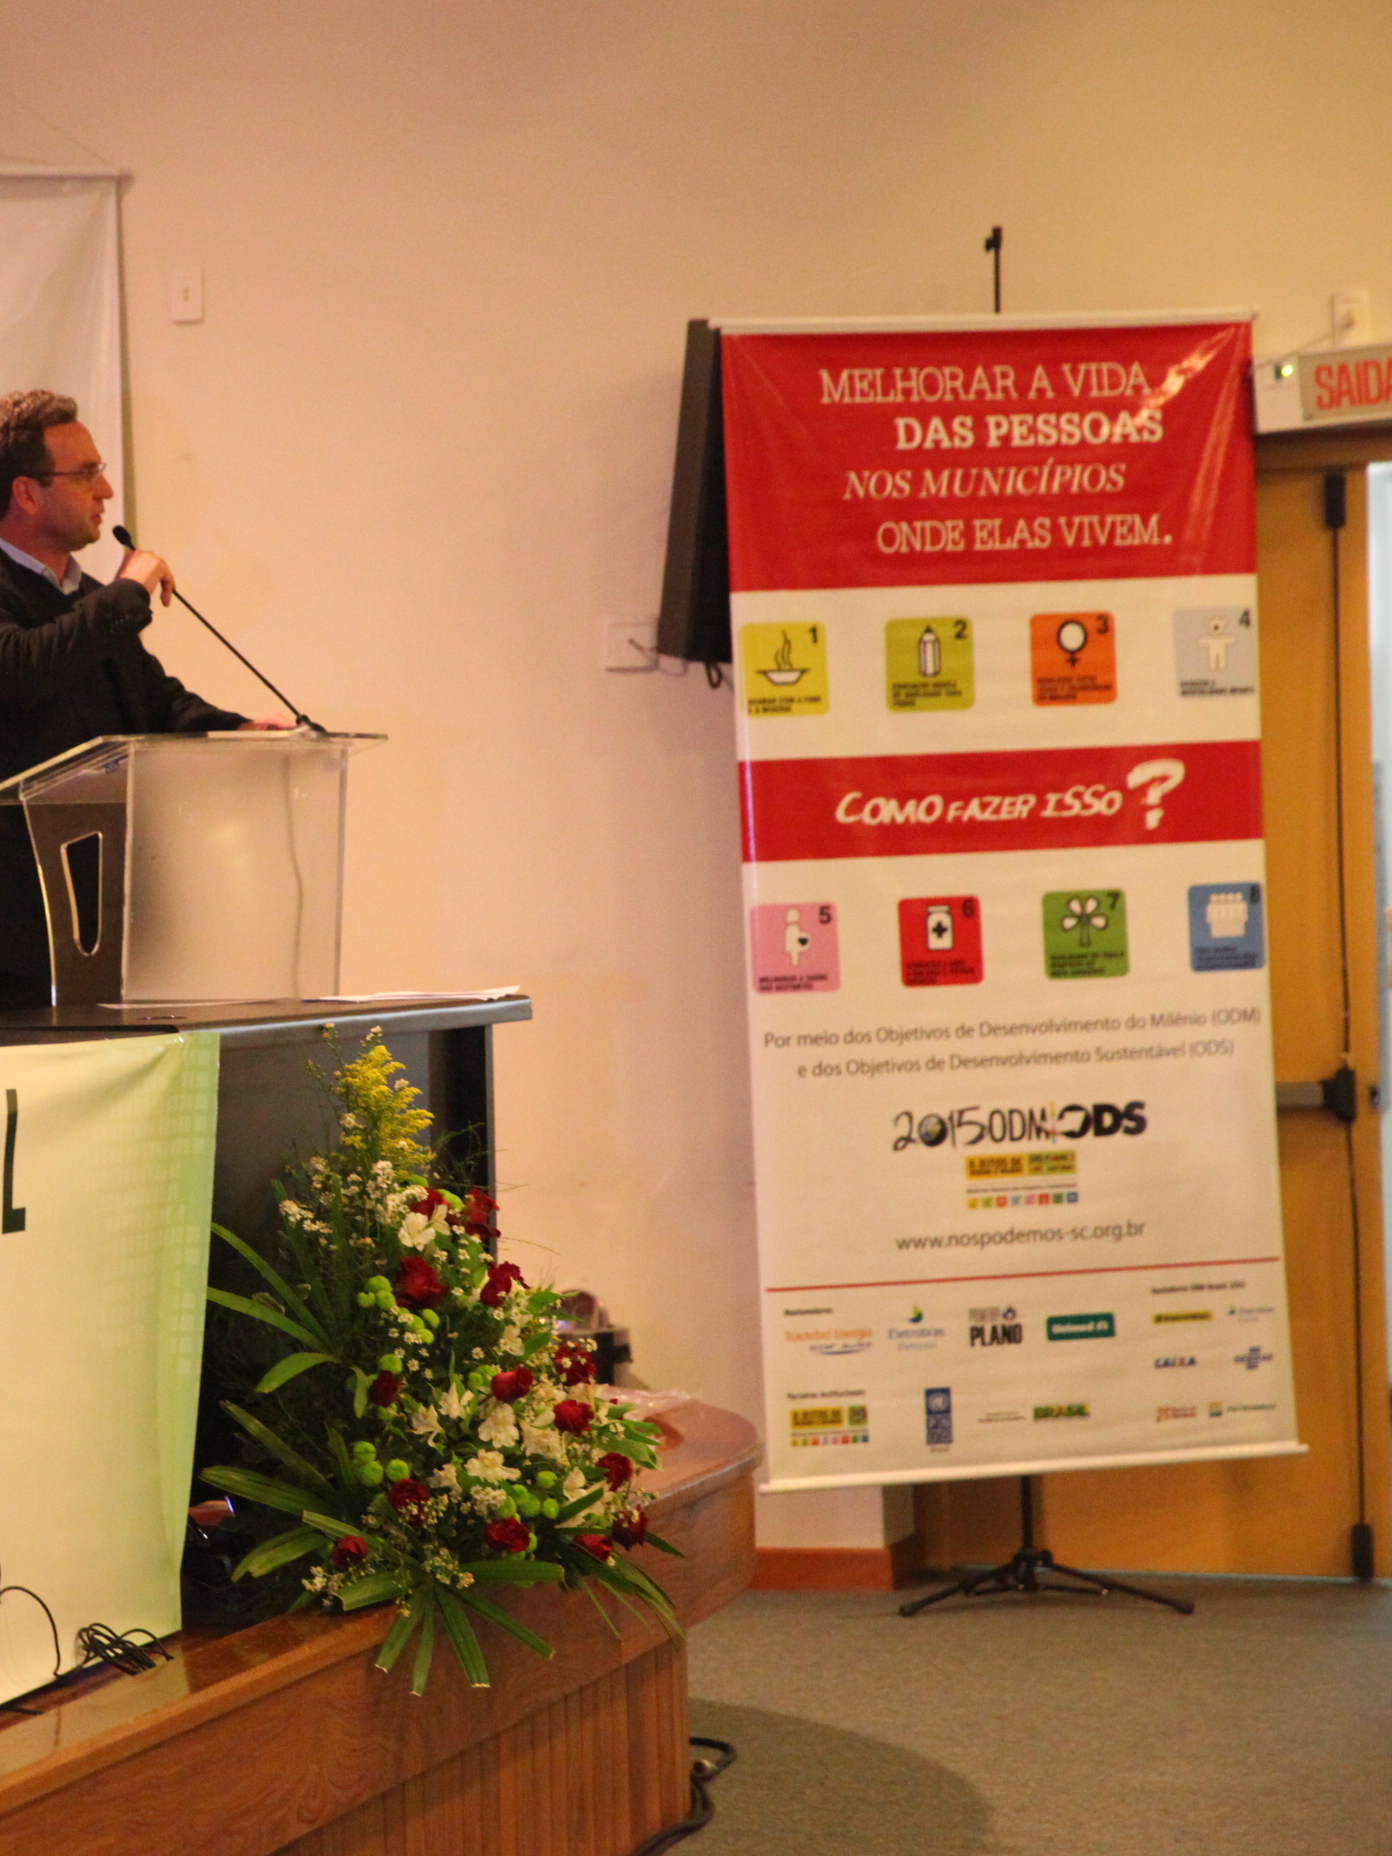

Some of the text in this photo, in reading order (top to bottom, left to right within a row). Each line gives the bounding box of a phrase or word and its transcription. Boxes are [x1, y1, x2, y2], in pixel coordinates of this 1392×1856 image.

[819, 361, 1152, 404] MELHORAR A VIDA
[895, 409, 1164, 450] DAS PESSOAS
[843, 456, 1127, 501] NOS MUNICÍPIOS
[877, 512, 1173, 553] ONDE ELAS VIVEM.
[954, 620, 968, 641] 2
[1095, 615, 1109, 635] 3
[1239, 609, 1252, 628] 4
[809, 626, 818, 645] 1
[835, 791, 945, 826] COMO
[946, 794, 1037, 823] FAZER
[818, 905, 832, 925] 5
[1107, 892, 1120, 910] 7
[764, 1031, 792, 1048] Por
[797, 1030, 840, 1047] meio
[843, 1027, 872, 1045] dos
[875, 1025, 951, 1046] Objetivos
[955, 1021, 974, 1039] de
[979, 1015, 1121, 1039] Desenvolvimento
[1125, 1013, 1146, 1030] do
[1150, 1010, 1207, 1028] Milênio
[797, 1064, 807, 1078] e
[812, 1060, 842, 1077] dos
[846, 1058, 922, 1078] Objetivos
[925, 1055, 945, 1071] de
[950, 1048, 1091, 1071] Desenvolvimento
[1095, 1041, 1186, 1062] Sustentável
[895, 1219, 1145, 1251] www.nospodemos-sc.org.br
[970, 1323, 1023, 1348] PLANO
